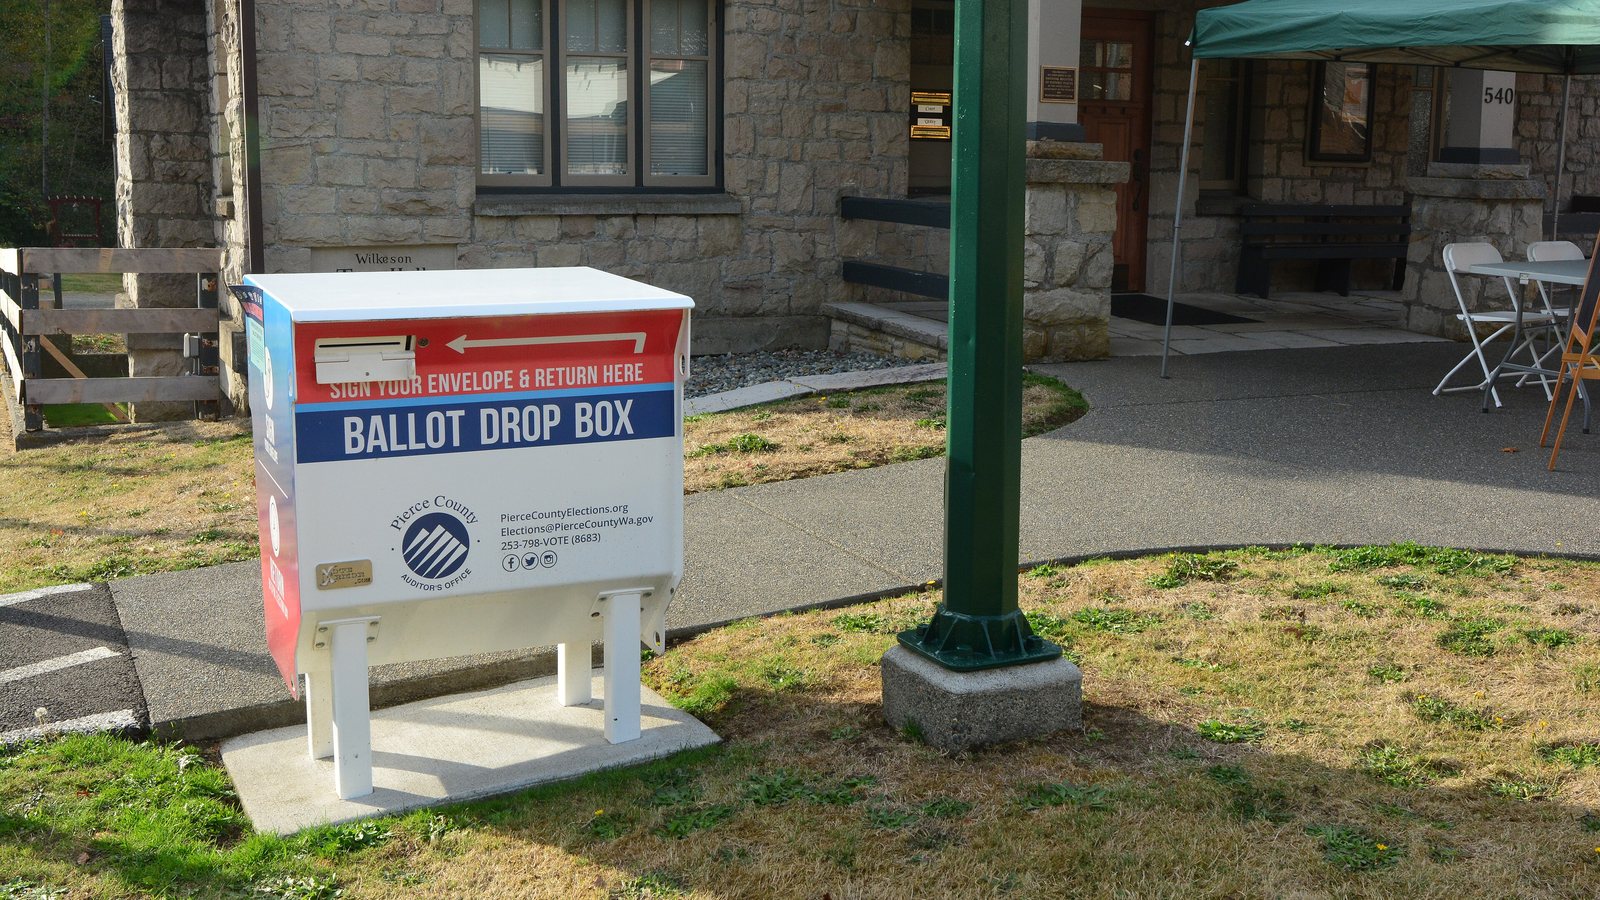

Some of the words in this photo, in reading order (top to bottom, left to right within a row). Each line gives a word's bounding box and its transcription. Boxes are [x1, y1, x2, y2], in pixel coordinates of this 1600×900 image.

[1484, 87, 1514, 104] 540
[355, 253, 412, 264] Wilkeson
[330, 381, 371, 399] SIGN
[377, 375, 422, 396] YOUR
[428, 369, 514, 394] ENVELOPE
[519, 369, 530, 388] &
[535, 365, 598, 388] RETURN
[603, 363, 644, 384] HERE
[343, 409, 465, 455] BALLOT
[479, 404, 561, 445] DROP
[574, 399, 634, 439] BOX
[390, 499, 431, 531] Pierce
[434, 495, 479, 525] County
[500, 504, 629, 523] PierceCountyElections.org
[501, 515, 654, 537] Elections@PierceCountyWa.gov
[501, 535, 569, 550] 253-798-VOTE
[571, 533, 601, 546] (8683)
[401, 574, 443, 591] AUDITOR'S
[444, 567, 472, 589] OFFICE
